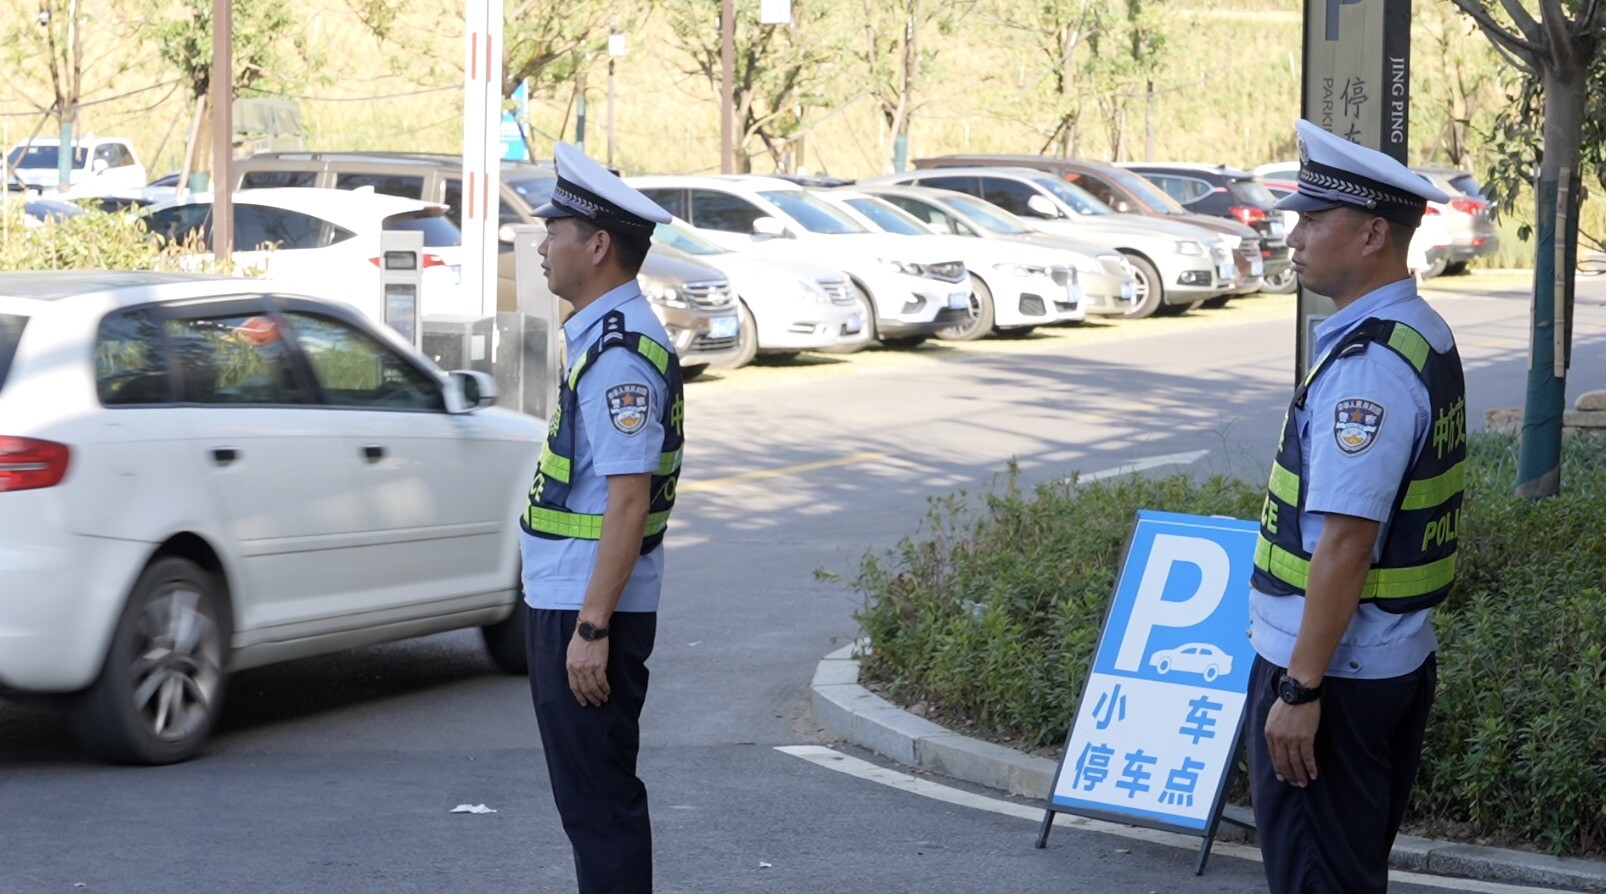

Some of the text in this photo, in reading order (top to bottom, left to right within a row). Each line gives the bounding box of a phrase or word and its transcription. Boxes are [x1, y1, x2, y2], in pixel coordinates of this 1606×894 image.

[1322, 77, 1334, 133] PARKI
[1389, 56, 1405, 144] JING PING
[1113, 532, 1230, 673] P
[1091, 683, 1224, 746] 小 车
[1071, 741, 1206, 808] 停车点
